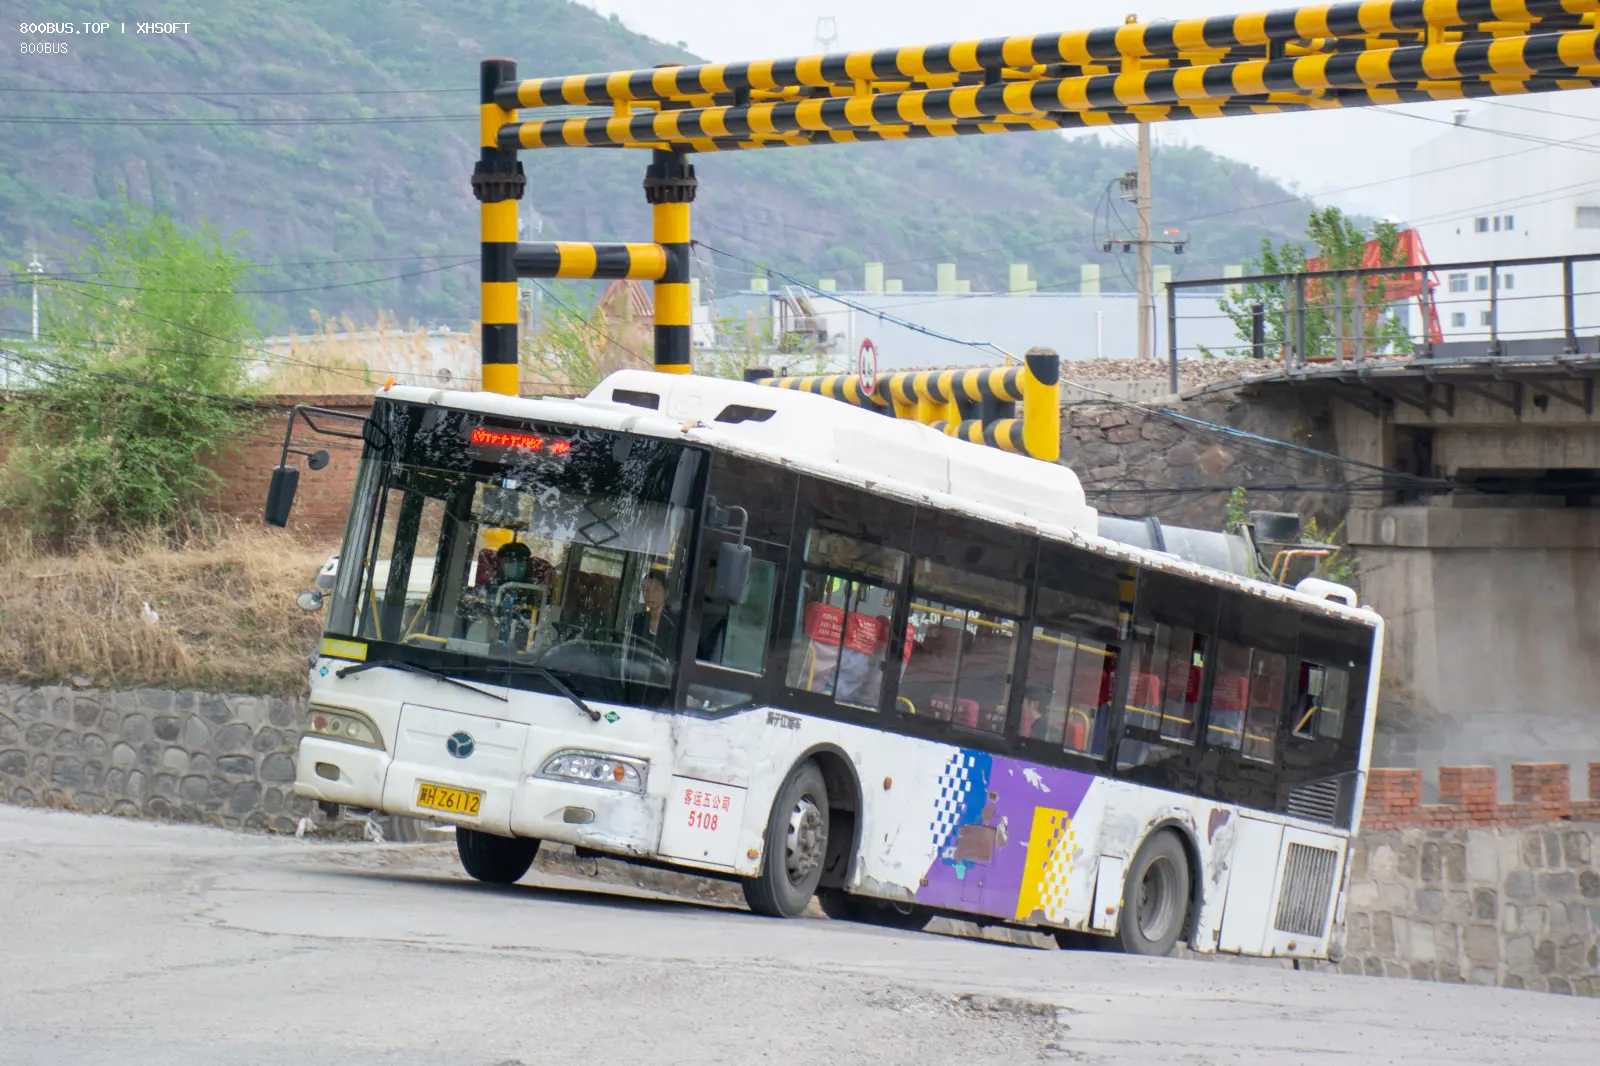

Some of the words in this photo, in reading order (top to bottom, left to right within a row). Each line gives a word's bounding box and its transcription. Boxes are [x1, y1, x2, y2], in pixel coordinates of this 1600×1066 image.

[684, 788, 731, 812] 客运五公司
[687, 810, 719, 831] 5108
